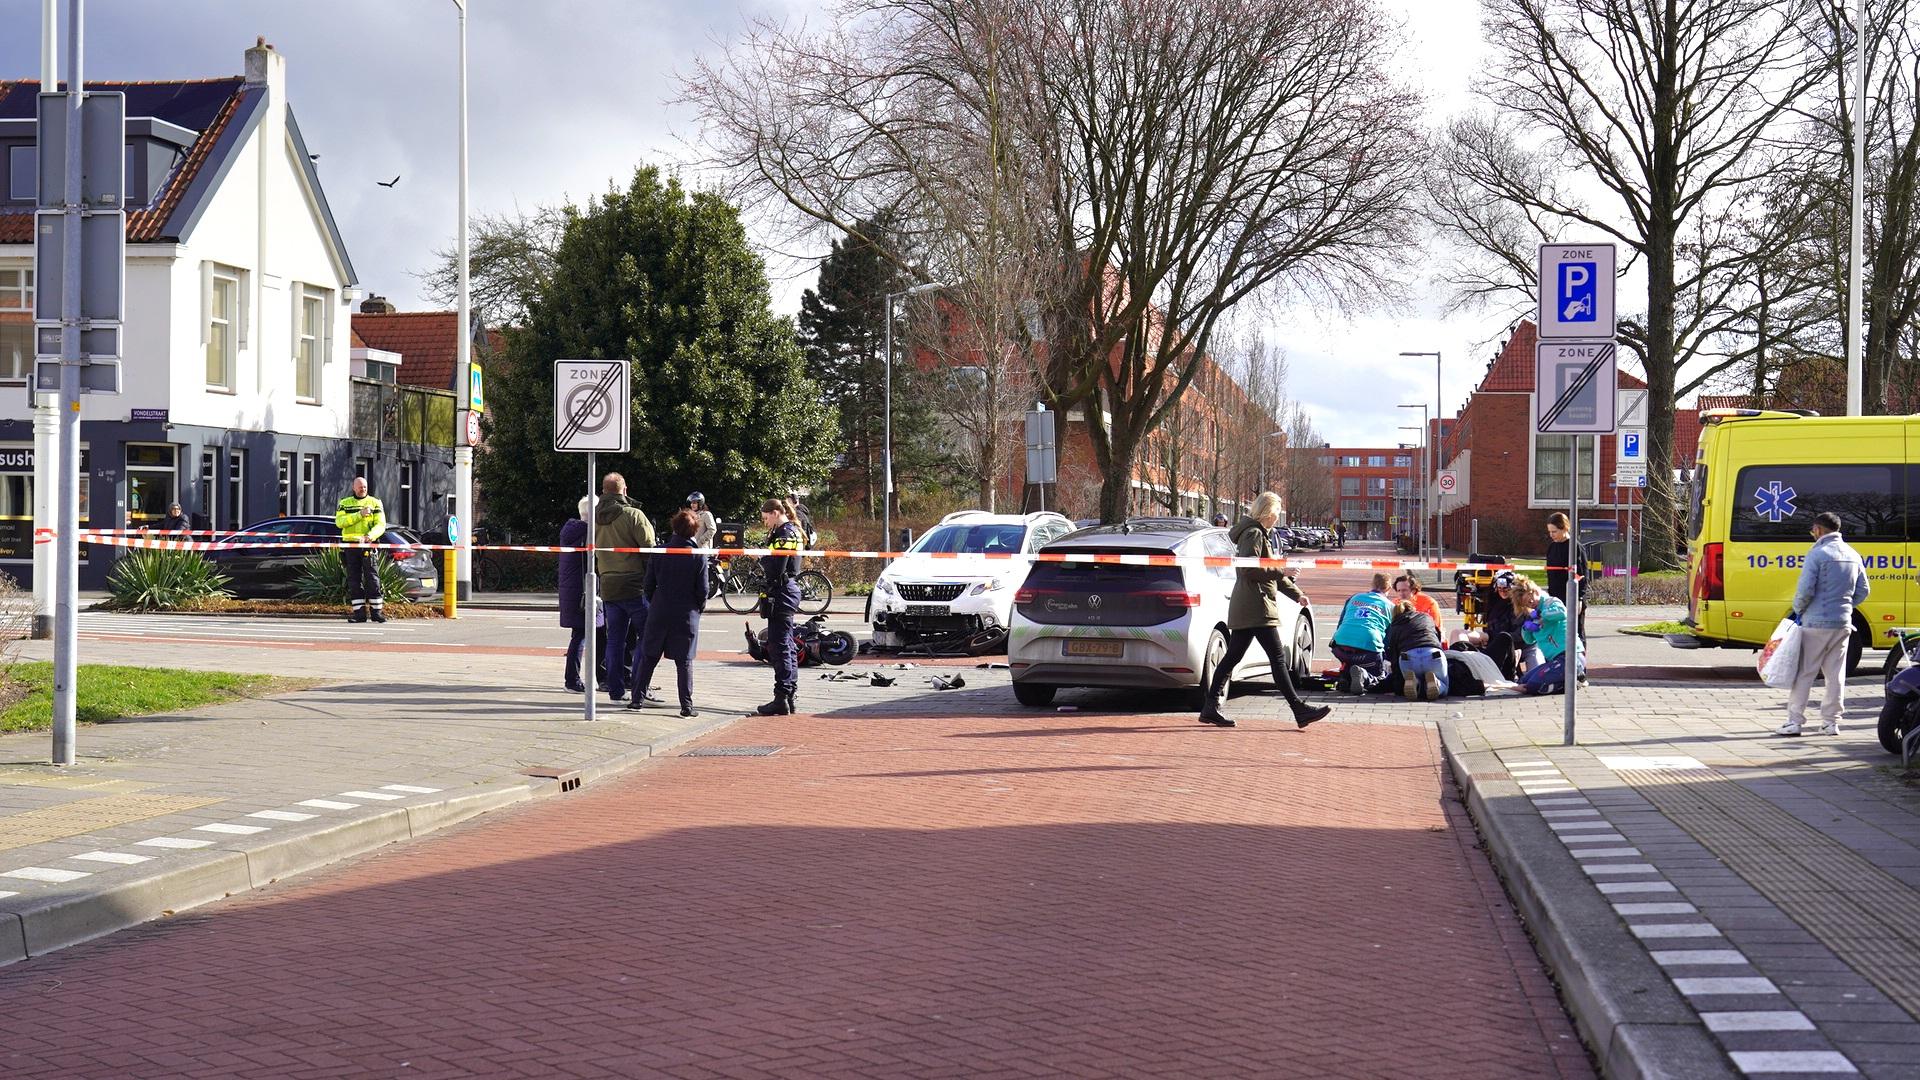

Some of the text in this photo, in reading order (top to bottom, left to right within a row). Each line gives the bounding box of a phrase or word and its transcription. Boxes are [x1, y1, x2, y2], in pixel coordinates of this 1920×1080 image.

[1562, 250, 1593, 259] ZONE
[1565, 265, 1589, 298] P
[1558, 348, 1594, 358] ZONE
[570, 369, 609, 379] ZONE
[1626, 435, 1637, 448] P
